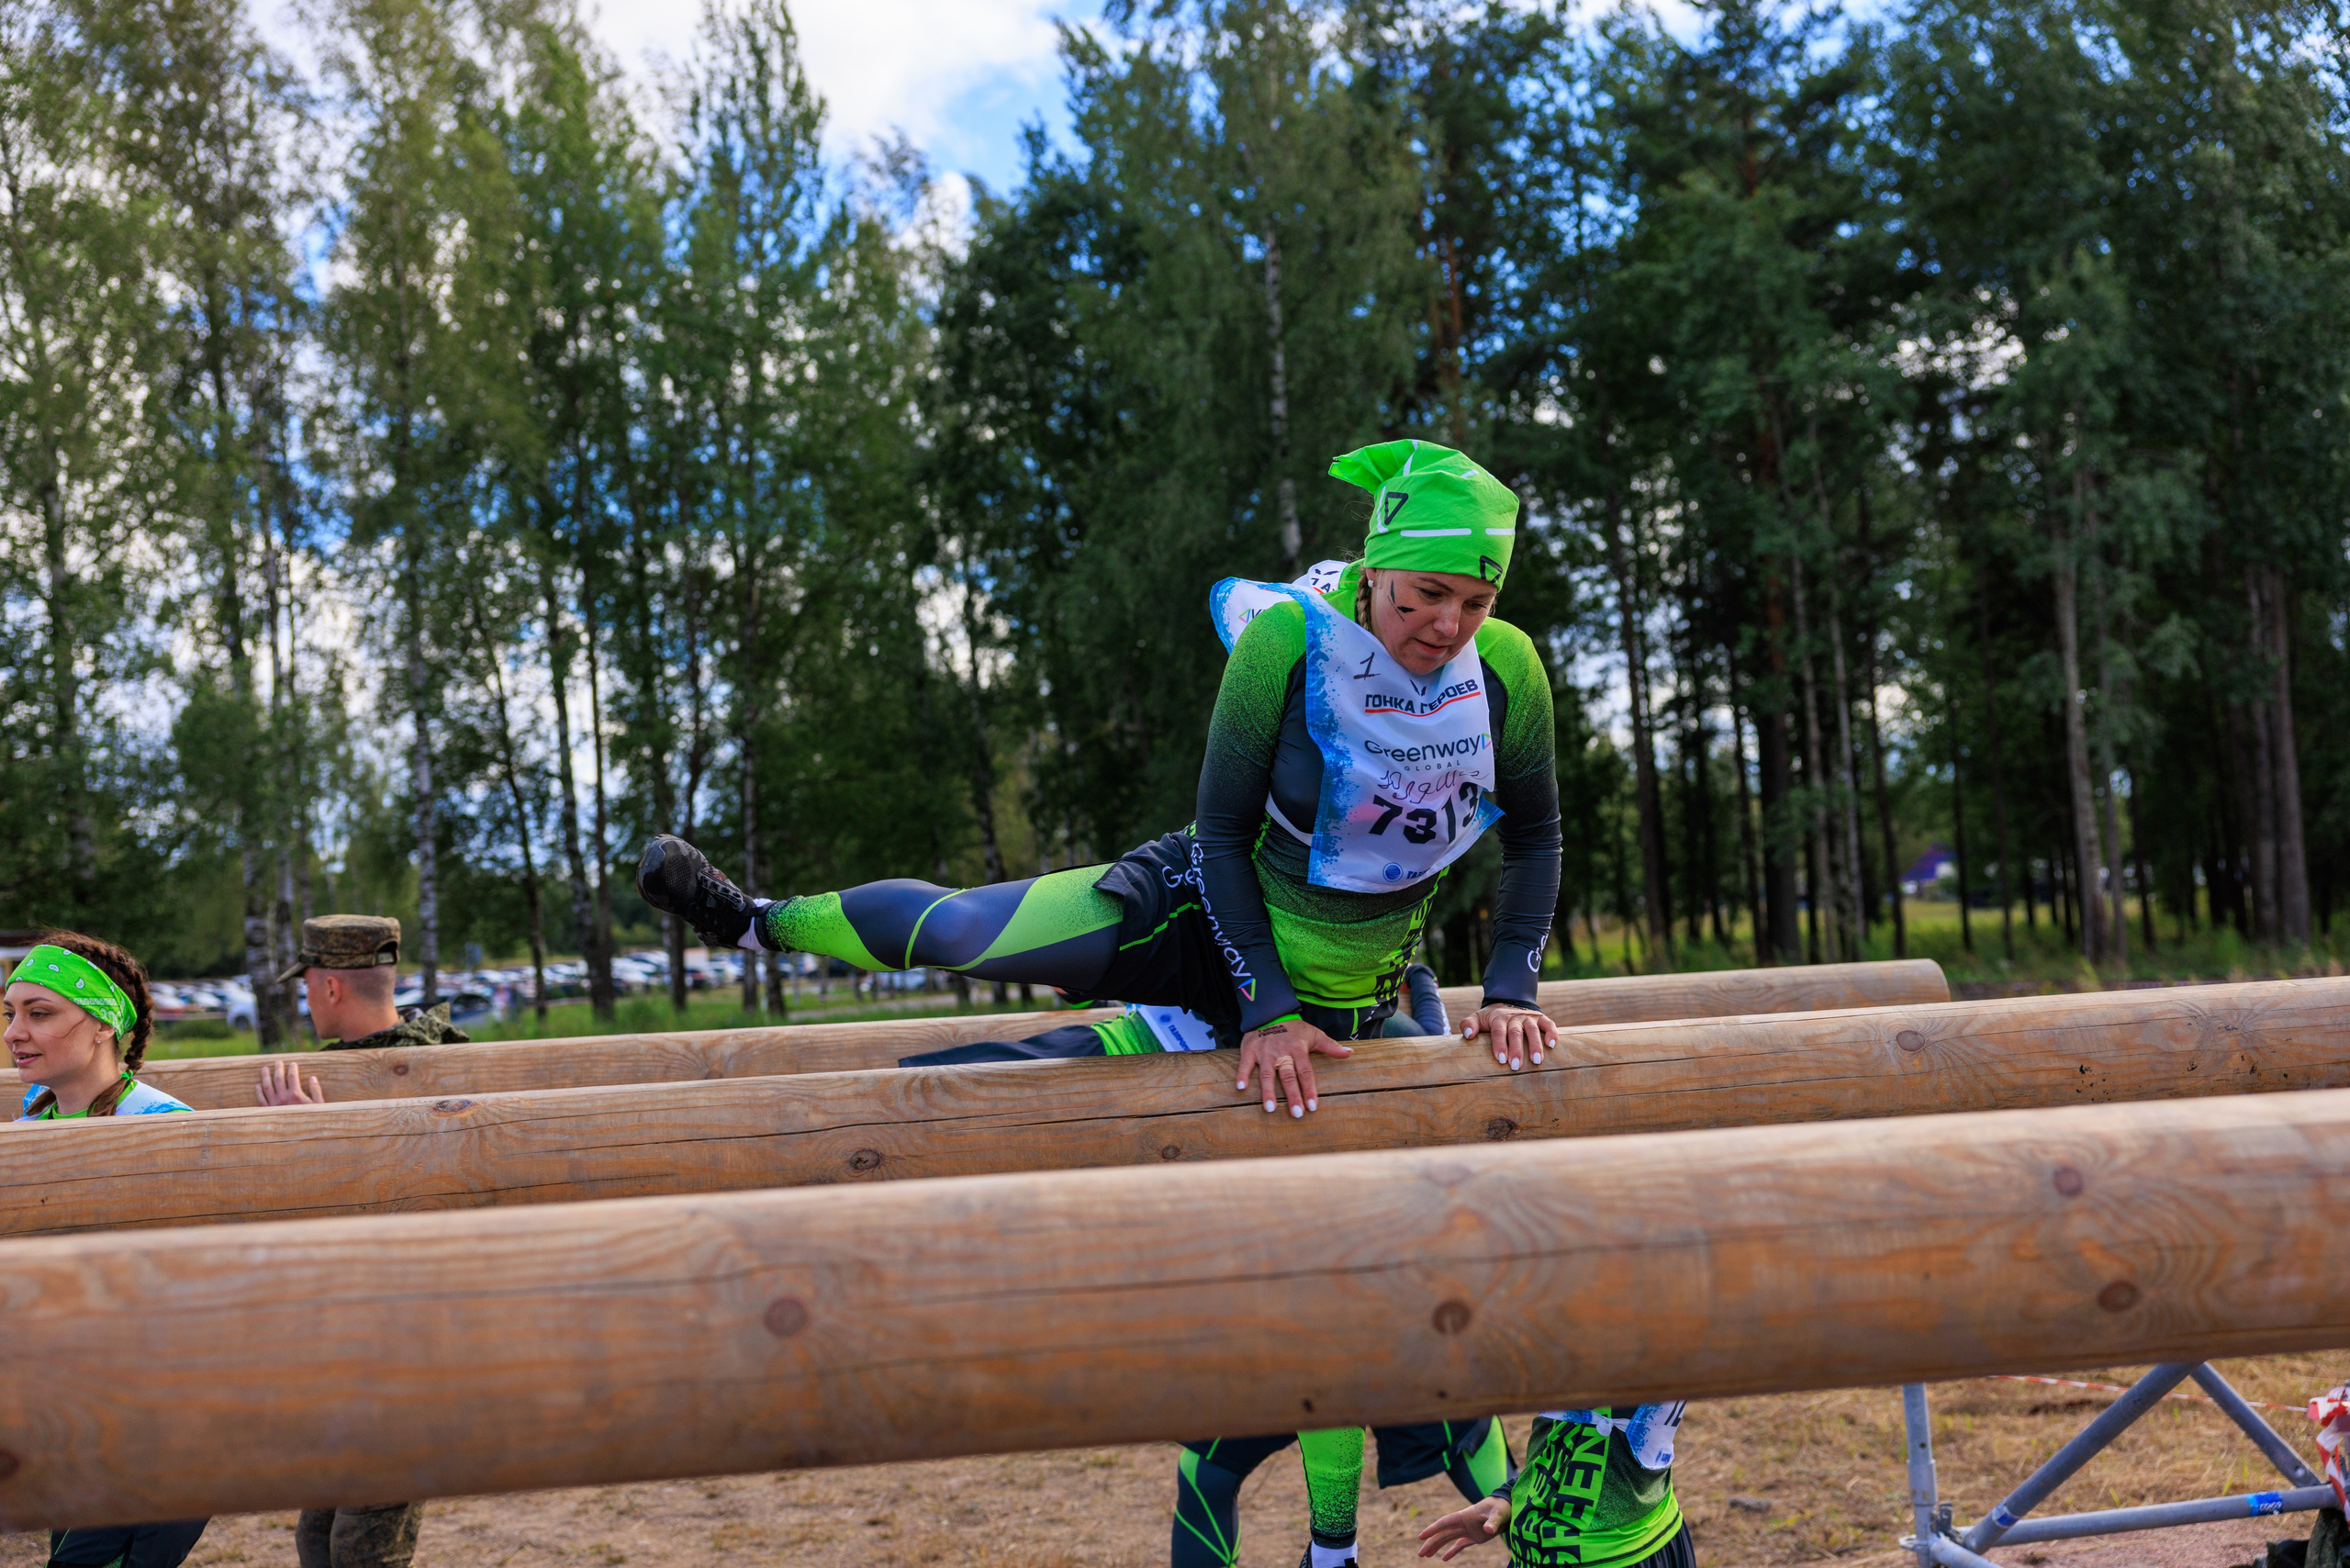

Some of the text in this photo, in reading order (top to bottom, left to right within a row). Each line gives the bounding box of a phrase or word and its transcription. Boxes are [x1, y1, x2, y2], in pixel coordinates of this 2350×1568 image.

[1353, 651, 1382, 681] 1
[1365, 678, 1479, 713] ГОНКА ГЕРОЕВ
[1365, 735, 1481, 762] Greenway
[1404, 759, 1461, 771] GLOBAL
[1369, 781, 1479, 845] 7313
[1191, 842, 1252, 977] Greenway
